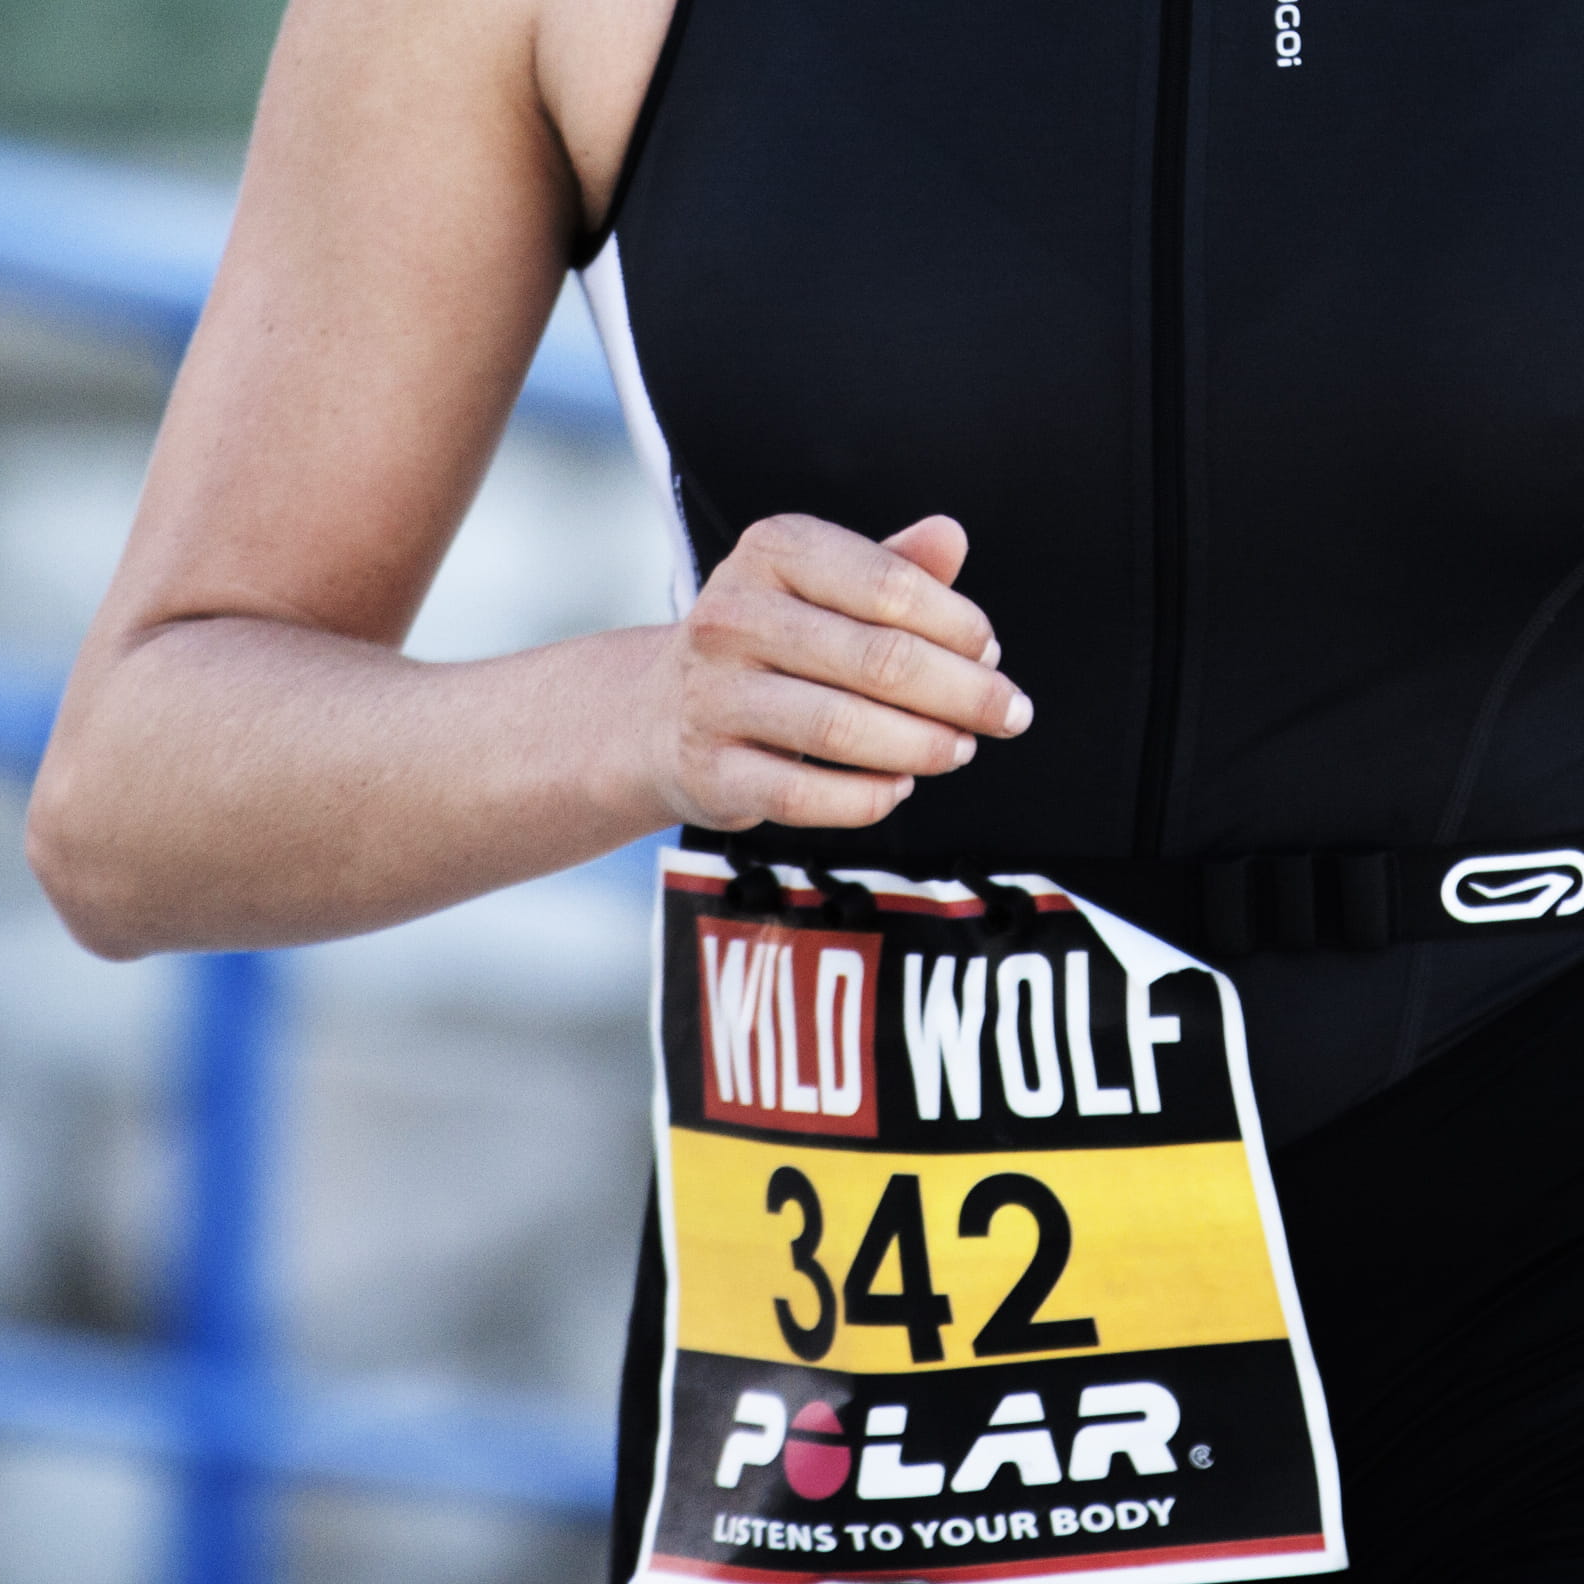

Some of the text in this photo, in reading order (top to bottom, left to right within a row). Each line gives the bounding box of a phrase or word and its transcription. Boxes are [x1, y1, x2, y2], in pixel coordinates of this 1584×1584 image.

[702, 933, 1182, 1121] WILD WOLF
[765, 1165, 1101, 1365] 342
[715, 1381, 1181, 1501] POLAR
[712, 1496, 1177, 1553] LISTENS TO YOUR BODY
